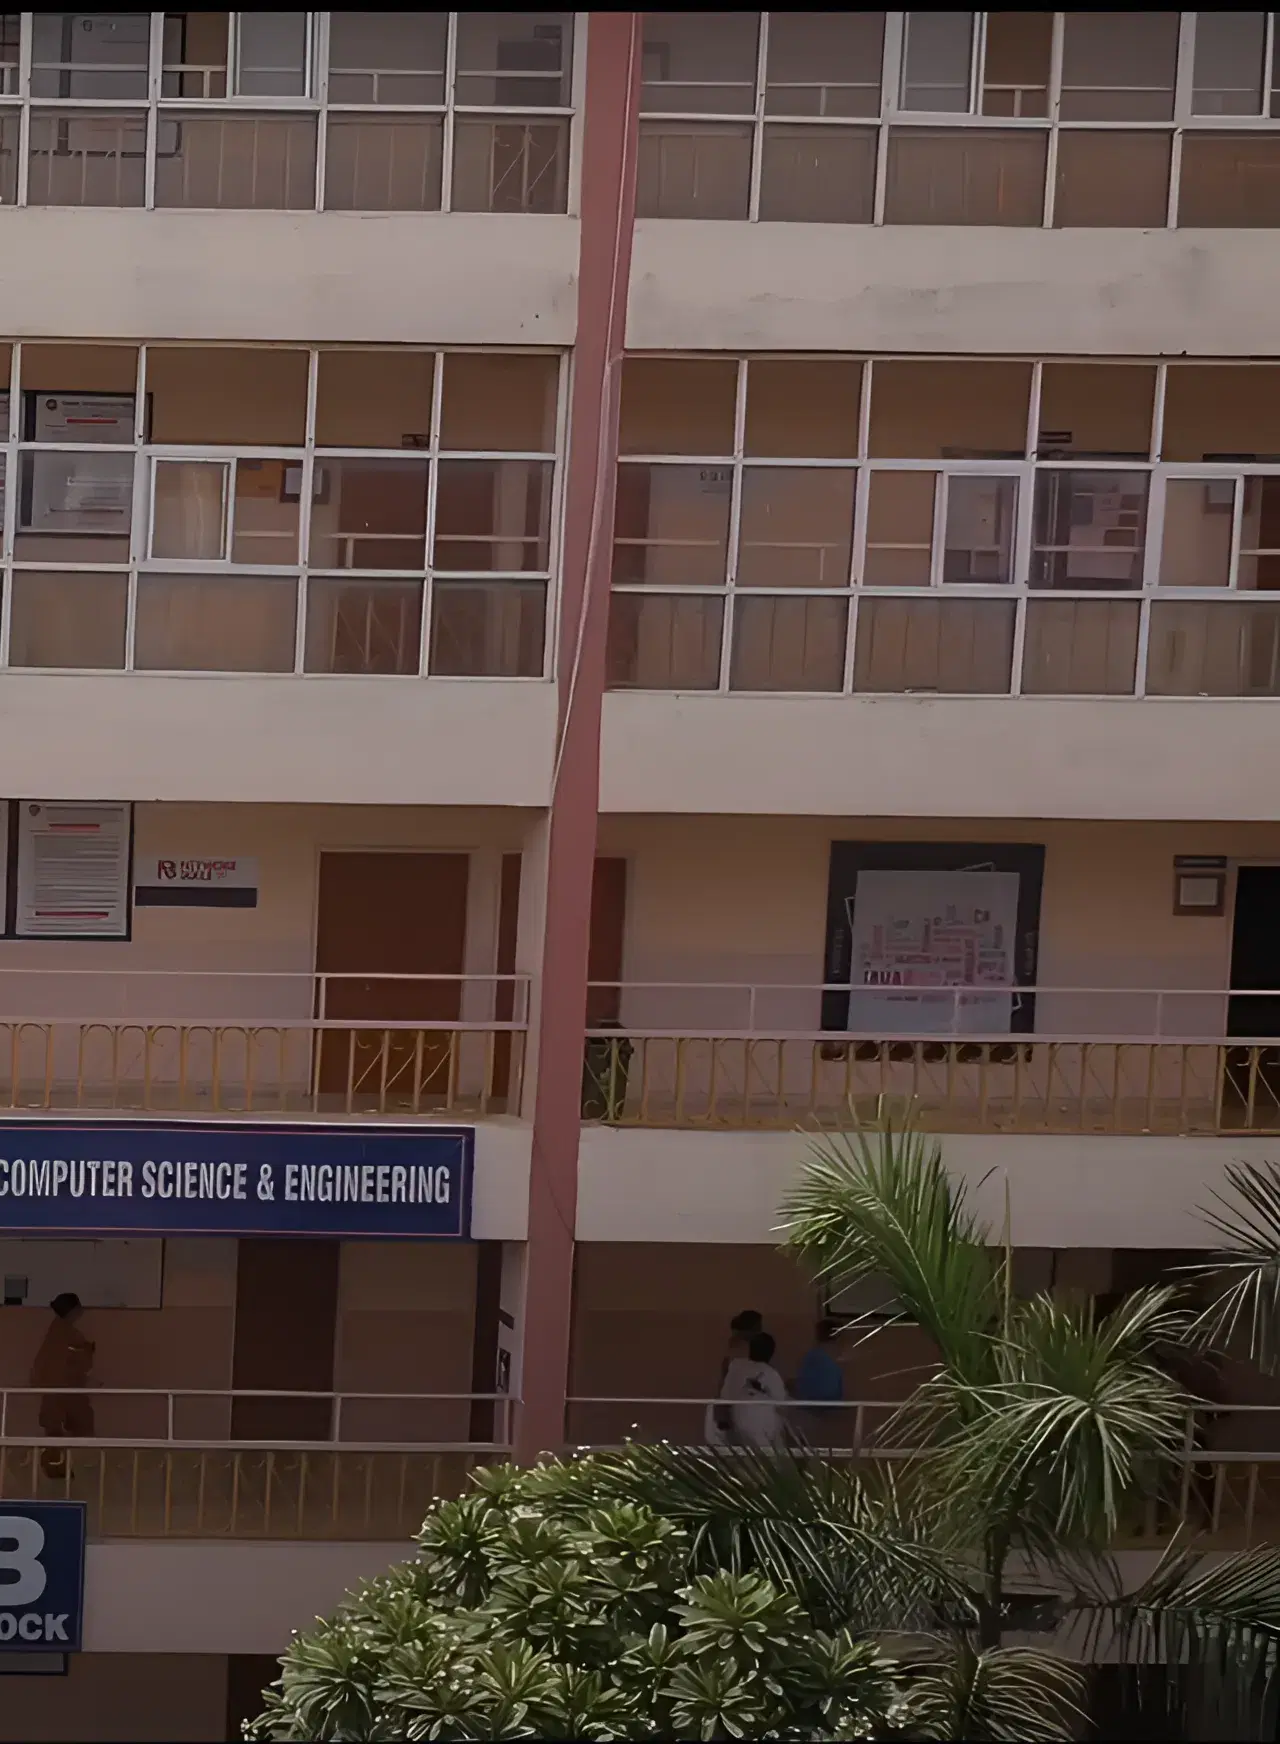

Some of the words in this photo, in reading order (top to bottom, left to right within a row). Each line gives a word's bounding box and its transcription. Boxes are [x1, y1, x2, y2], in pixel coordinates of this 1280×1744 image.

[141, 1160, 248, 1200] SCIENCE
[256, 1163, 275, 1201] &
[284, 1163, 451, 1204] ENGINEERING
